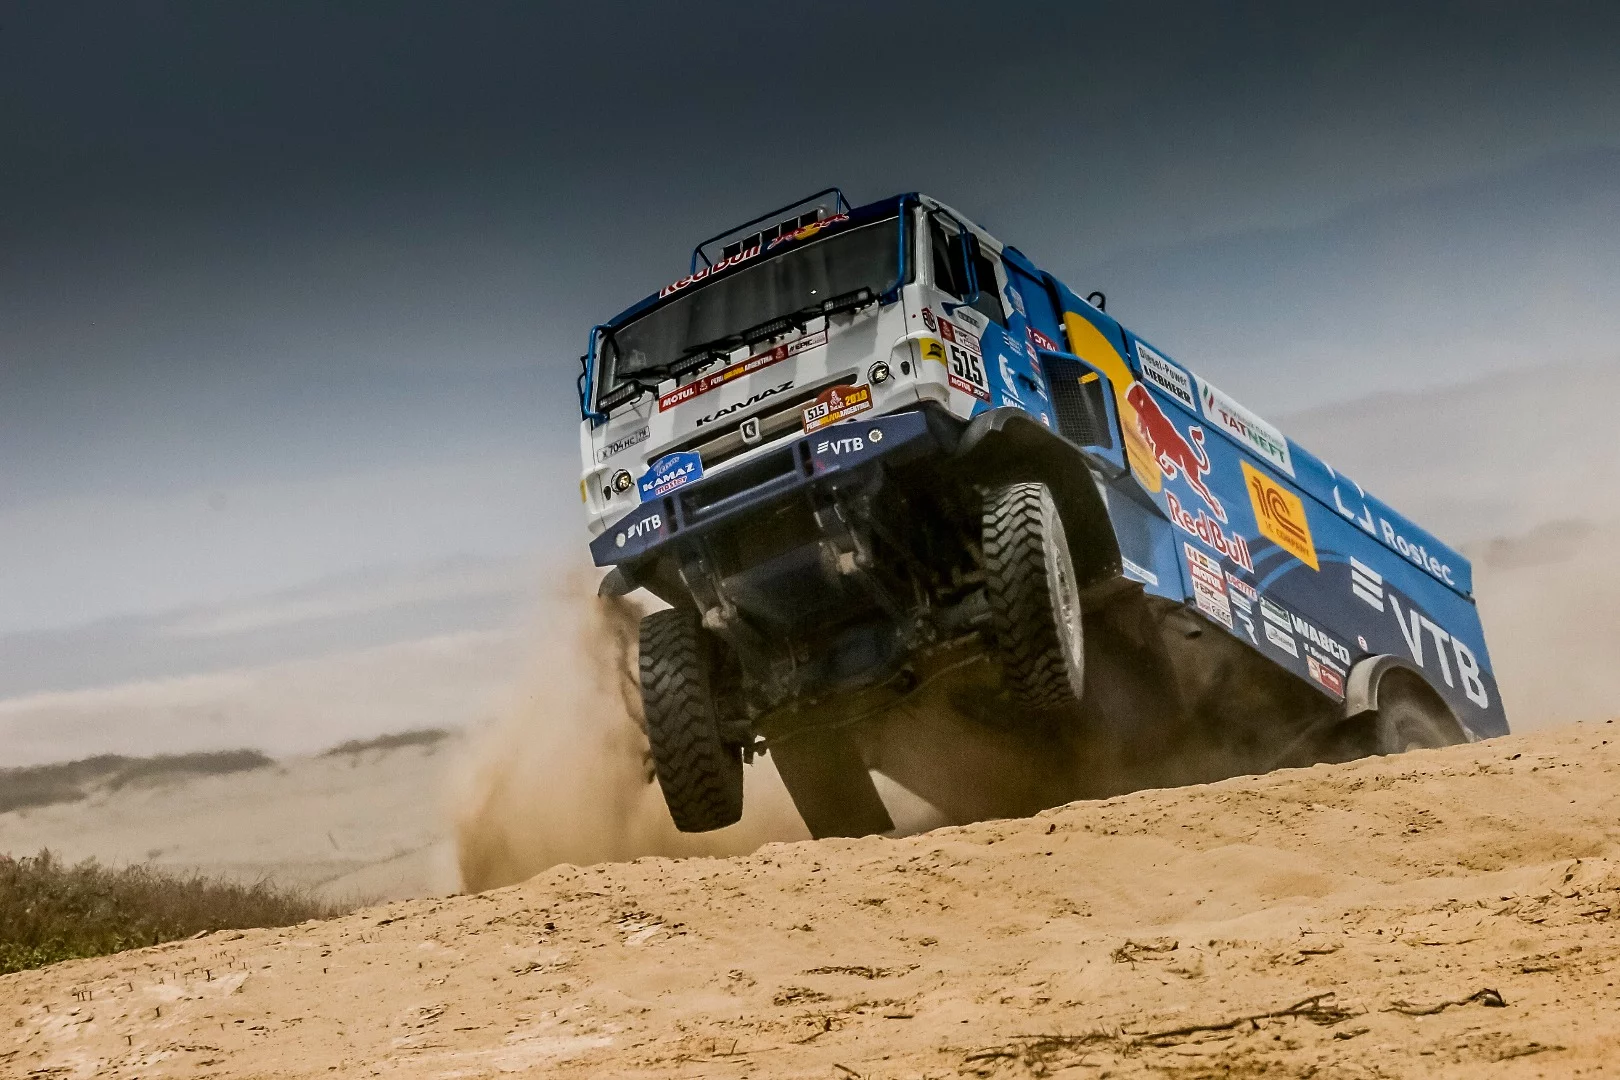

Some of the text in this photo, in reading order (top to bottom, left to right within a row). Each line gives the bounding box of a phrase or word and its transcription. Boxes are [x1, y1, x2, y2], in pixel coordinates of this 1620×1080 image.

[659, 245, 761, 299] Red Bull
[950, 344, 984, 388] 515
[951, 376, 972, 392] MOTUL
[1143, 364, 1193, 406] LIEBHERR
[662, 387, 695, 408] MOTUL
[710, 374, 723, 386] PERU
[696, 380, 795, 428] KAMAZ
[845, 389, 868, 407] 2018
[807, 404, 826, 421] 515
[830, 437, 864, 455] VTB
[1218, 408, 1286, 464] TATNEFT
[643, 462, 696, 492] KAMAZ
[655, 475, 688, 497] master
[636, 514, 662, 537] VTB
[1164, 488, 1214, 547] Red
[1207, 516, 1255, 574] Bull
[1379, 517, 1456, 586] Rostec
[1192, 564, 1224, 592] MOTUL
[1290, 612, 1351, 667] WABCO
[1388, 593, 1489, 710] VTB
